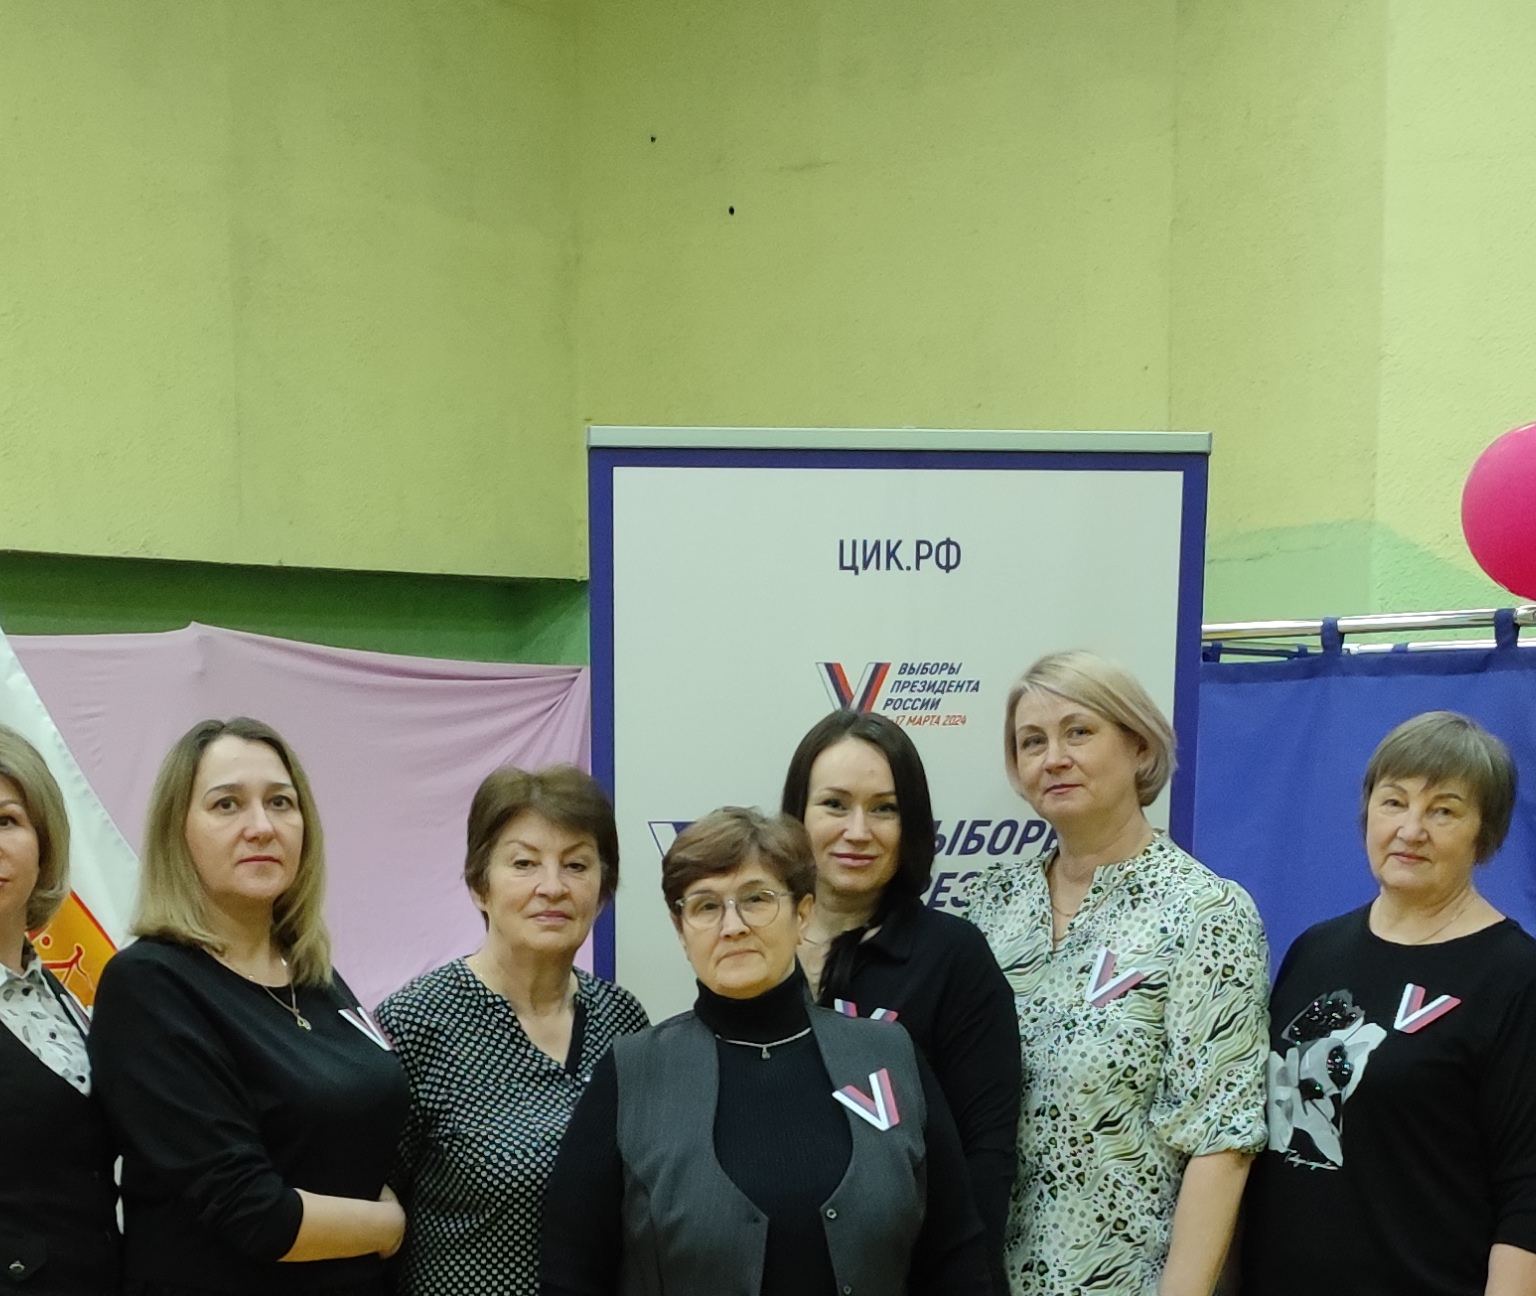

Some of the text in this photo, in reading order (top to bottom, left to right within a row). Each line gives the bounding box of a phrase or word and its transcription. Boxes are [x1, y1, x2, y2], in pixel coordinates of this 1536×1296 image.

[838, 537, 962, 576] ЦИК.РФ
[897, 662, 963, 676] ВЫБОРЫ
[889, 679, 981, 695] ПРЕЗИДЕНТА
[882, 697, 942, 712] РОССИИ
[905, 715, 941, 727] МАРТА
[933, 819, 1059, 857] ЫБОР
